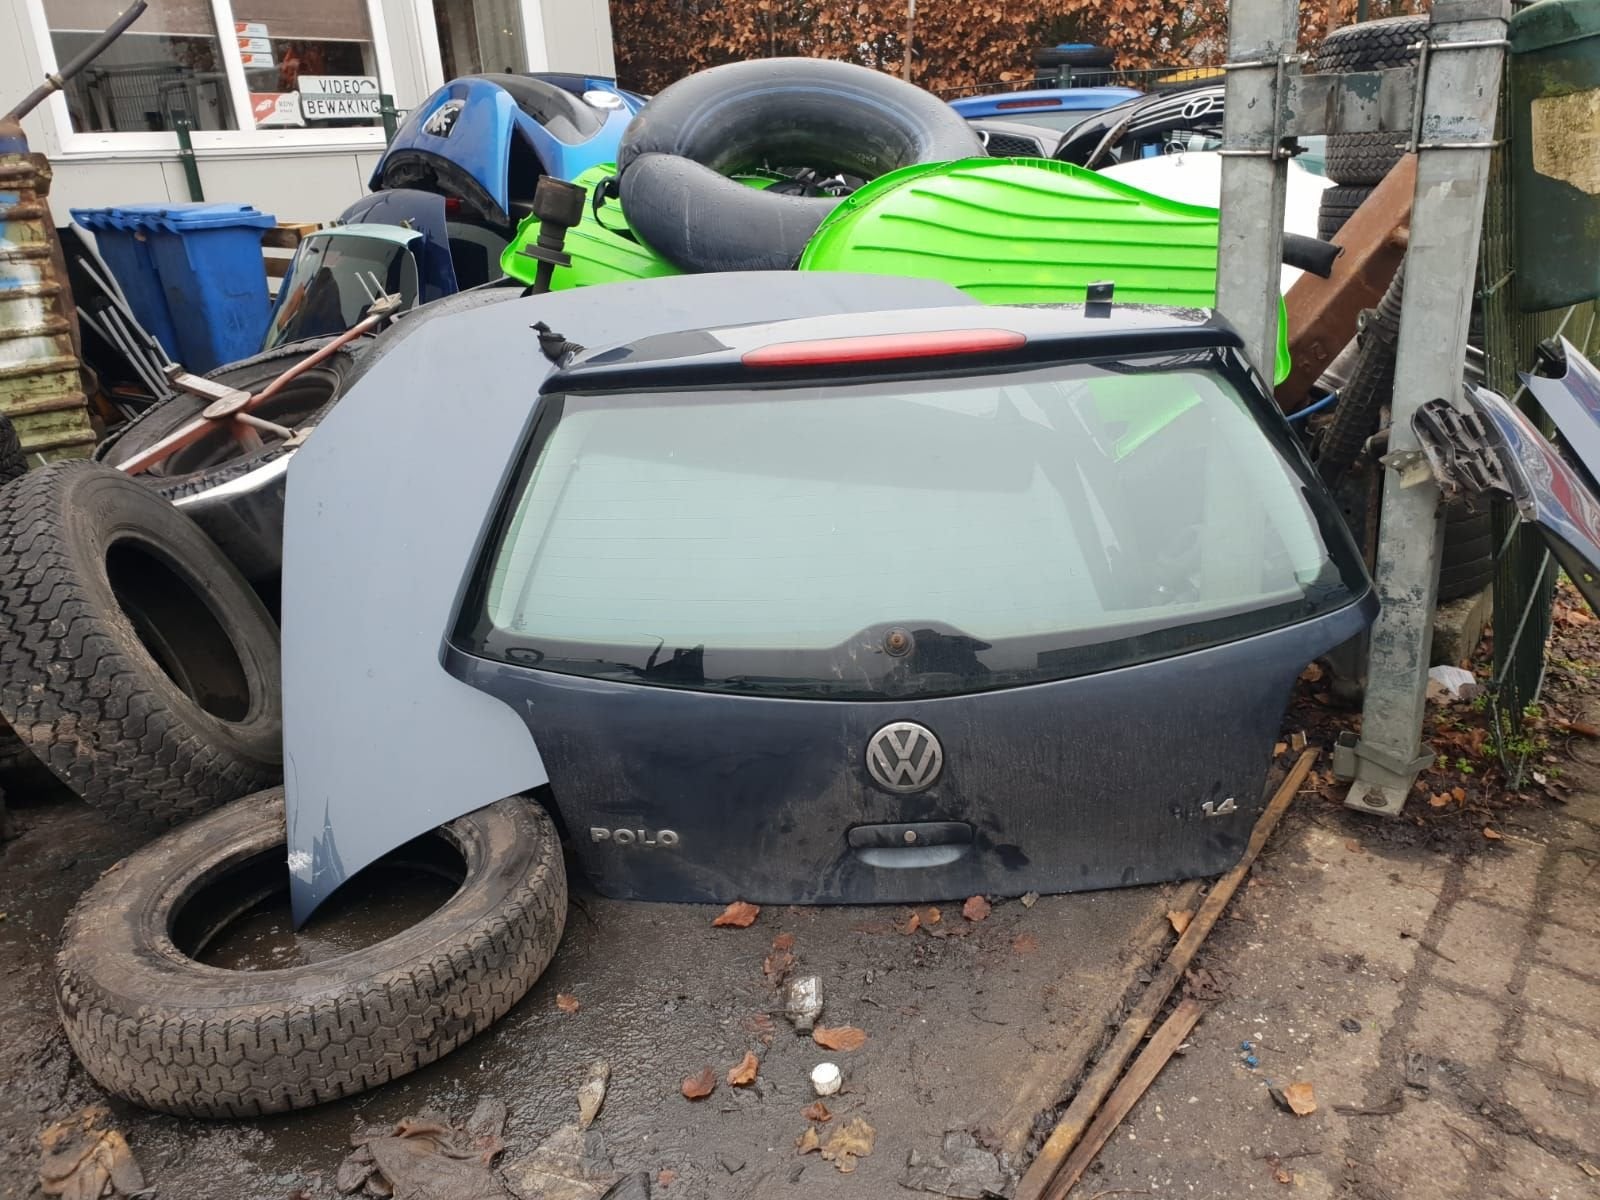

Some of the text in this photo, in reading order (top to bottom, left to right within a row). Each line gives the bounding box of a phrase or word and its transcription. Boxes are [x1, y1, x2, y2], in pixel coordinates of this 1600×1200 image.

[319, 79, 360, 94] VIDEO
[307, 100, 379, 114] BEWAKING
[590, 827, 679, 847] POLO
